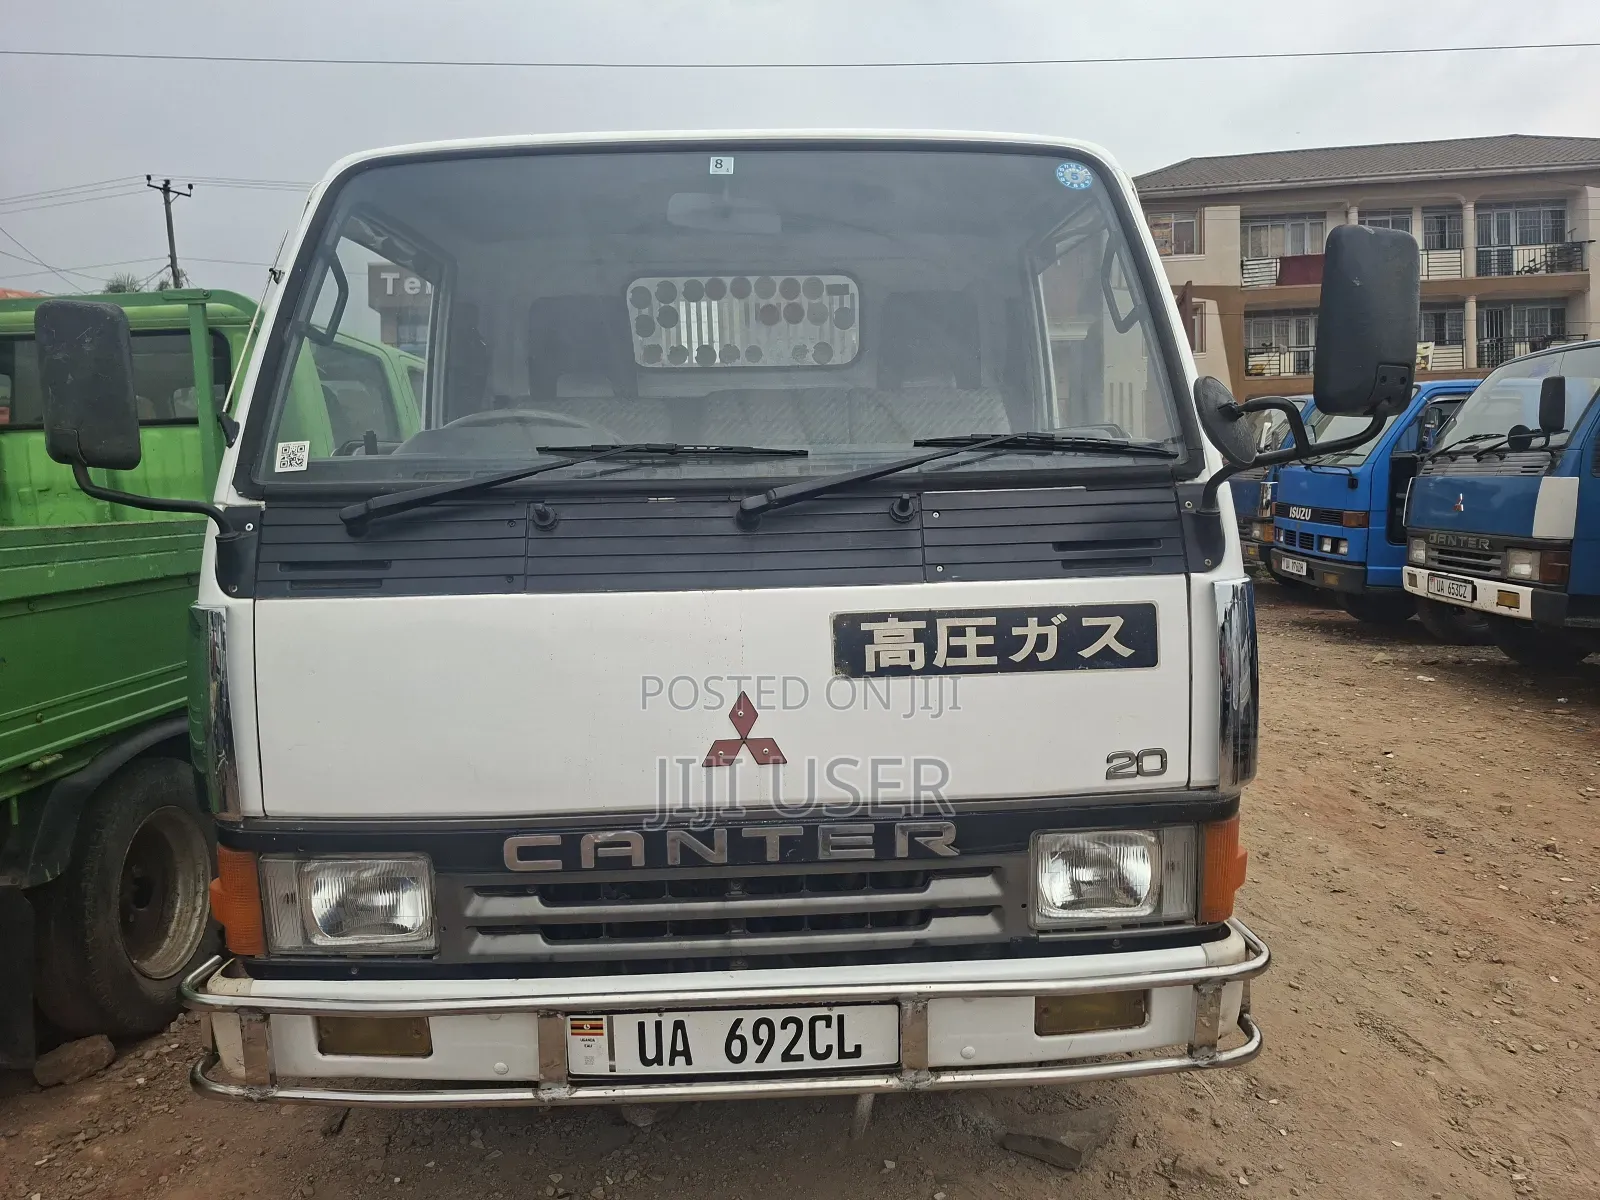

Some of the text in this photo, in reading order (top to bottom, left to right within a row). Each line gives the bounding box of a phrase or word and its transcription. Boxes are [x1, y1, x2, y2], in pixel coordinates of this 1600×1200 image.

[715, 159, 723, 169] 8
[1289, 506, 1312, 520] ISUZU
[1436, 580, 1467, 598] UA 653CZ
[860, 613, 1136, 673] 高圧ガス
[1106, 748, 1168, 780] 20
[503, 820, 961, 873] CANTER
[638, 1014, 862, 1067] UA 692CL
